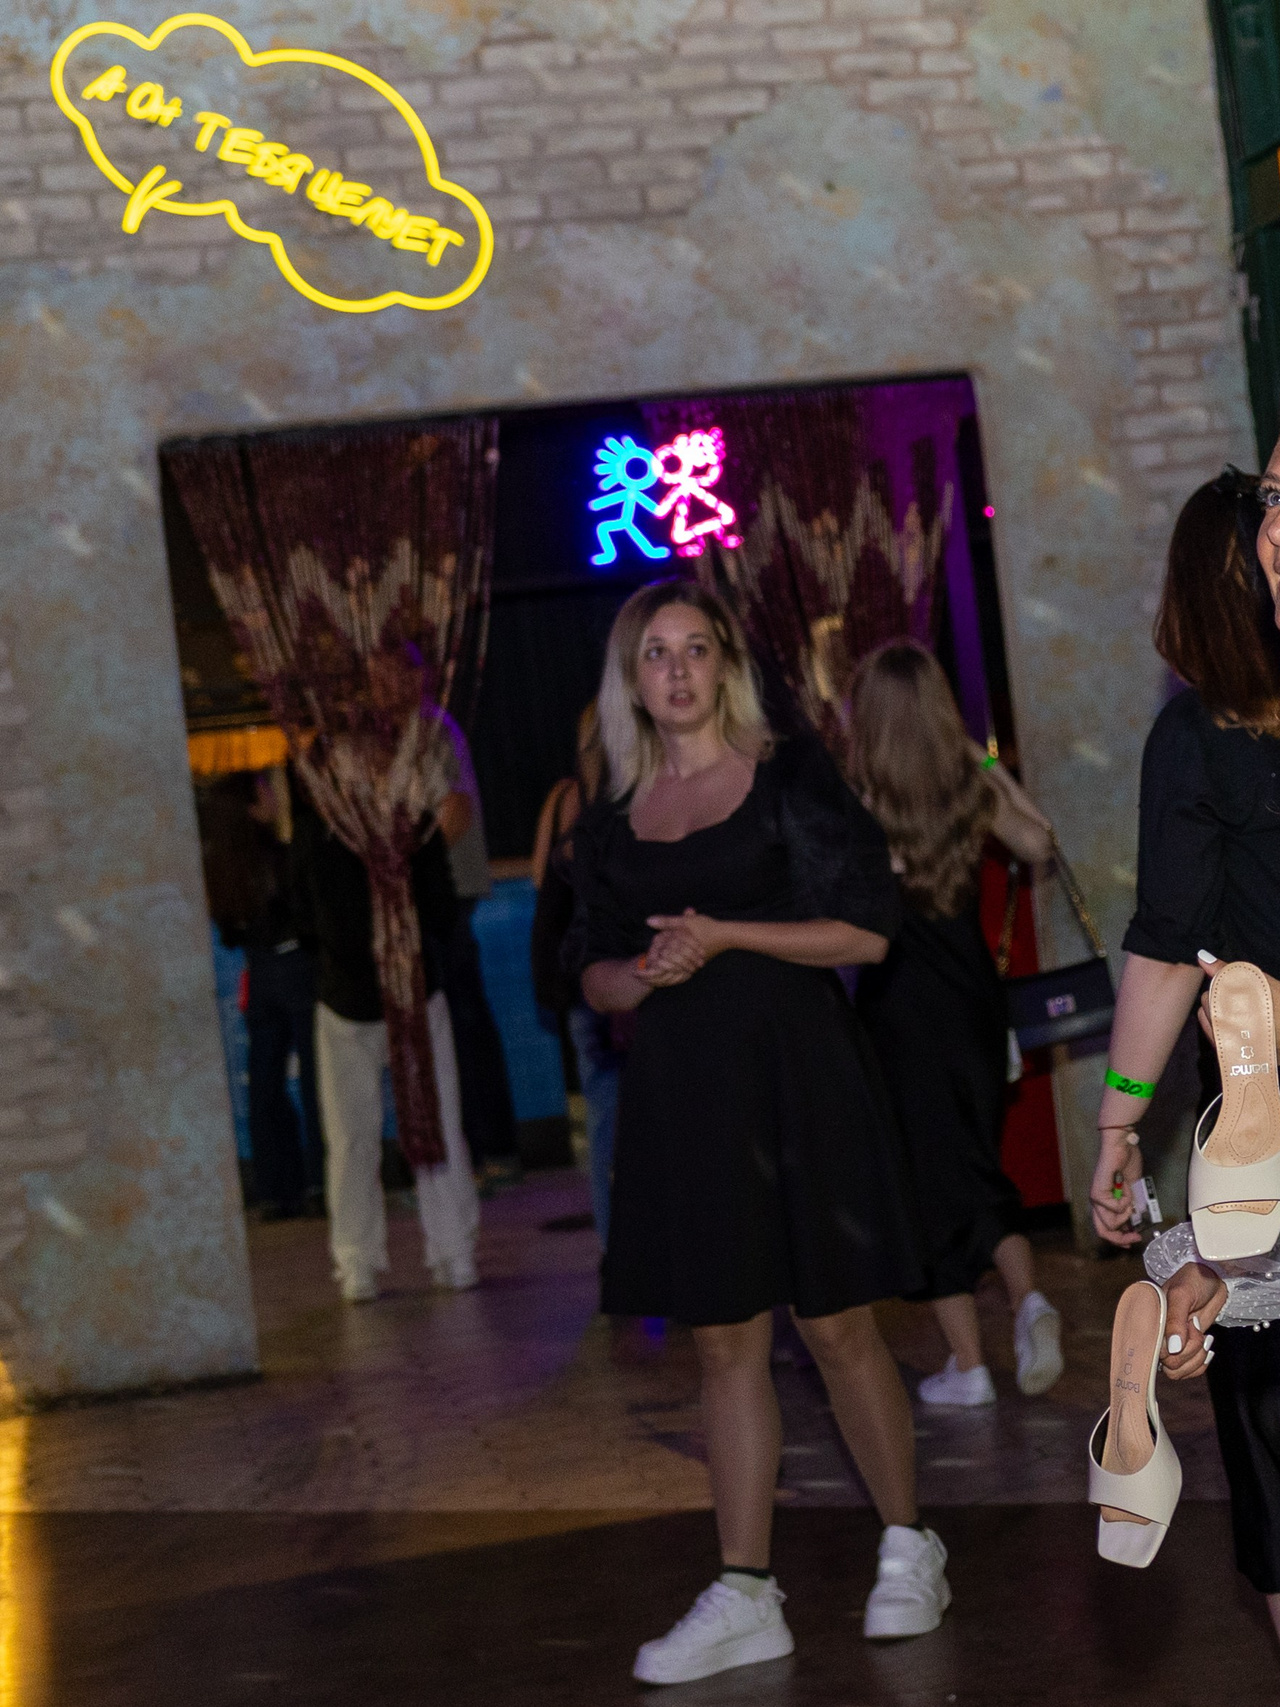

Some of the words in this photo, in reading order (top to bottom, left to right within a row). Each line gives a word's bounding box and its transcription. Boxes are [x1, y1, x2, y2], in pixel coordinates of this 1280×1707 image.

[126, 82, 183, 128] ОН
[194, 111, 314, 194] ТЕБЯ
[306, 168, 465, 267] ЦЕЛУЕТ
